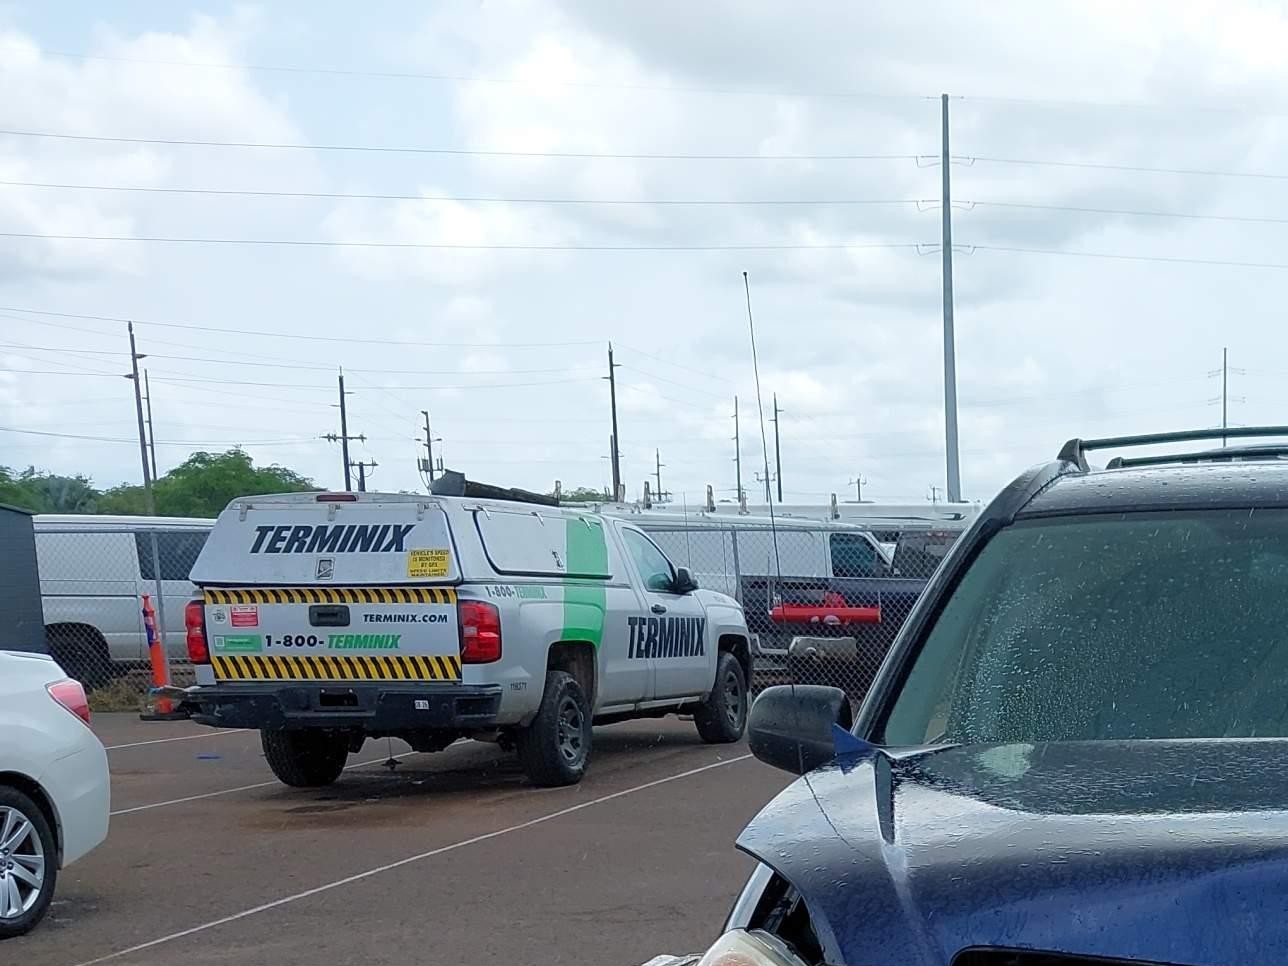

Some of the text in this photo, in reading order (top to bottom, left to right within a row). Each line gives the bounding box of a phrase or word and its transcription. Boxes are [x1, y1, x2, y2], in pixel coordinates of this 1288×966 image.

[250, 525, 416, 553] TERMINIX
[363, 614, 448, 623] TERMINIX.COM
[265, 634, 402, 649] 1-800-TERMINIX
[627, 617, 706, 659] TERMINIX
